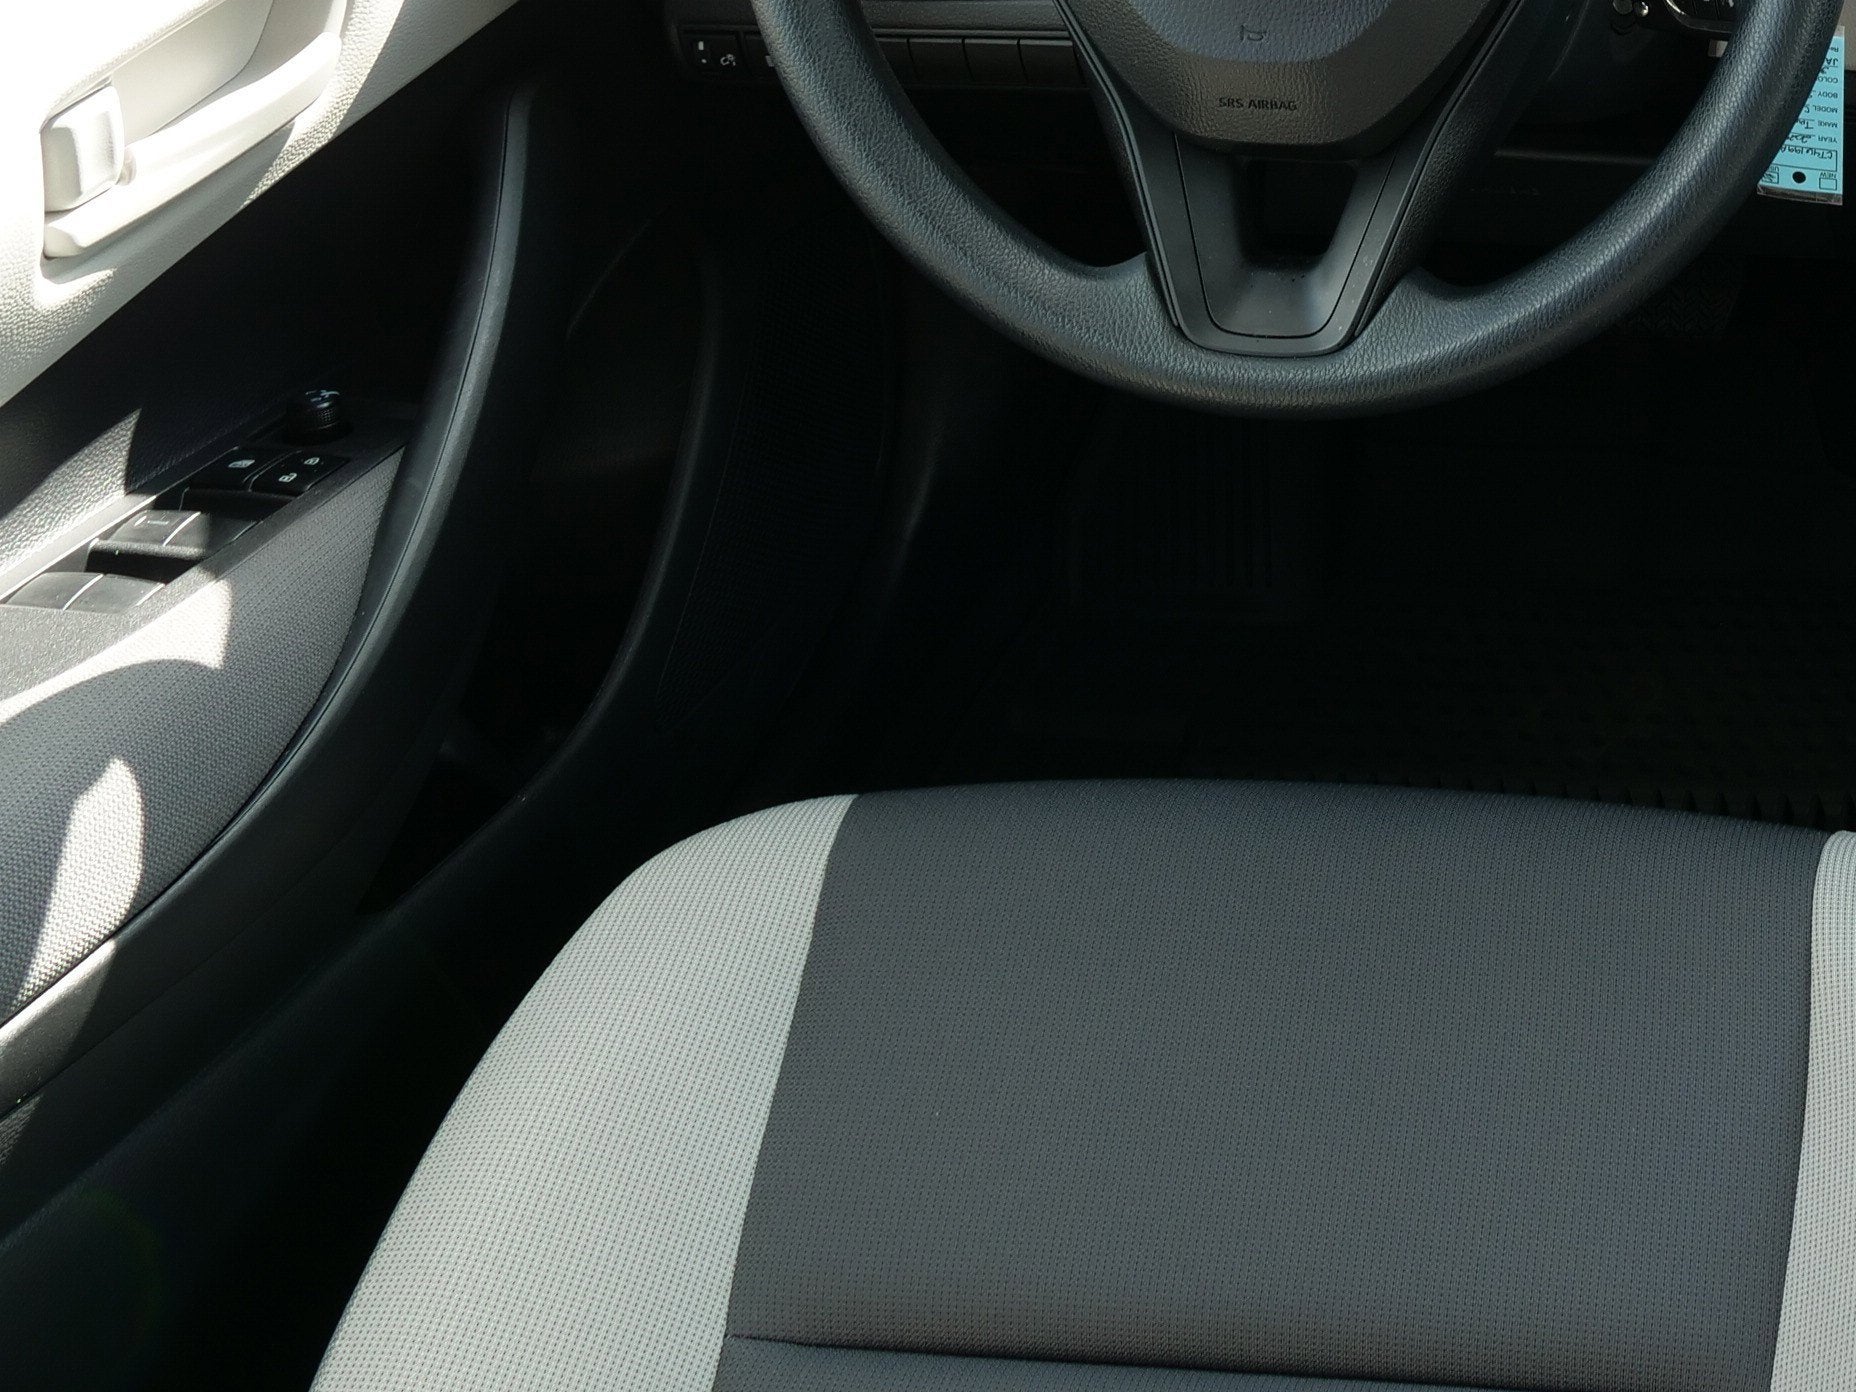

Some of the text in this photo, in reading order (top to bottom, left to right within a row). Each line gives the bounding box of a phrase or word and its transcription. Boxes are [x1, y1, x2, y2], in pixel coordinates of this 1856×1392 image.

[1219, 98, 1298, 111] SRS AIRBAG
[1813, 106, 1838, 114] MODEL
[1818, 136, 1838, 144] YEAR
